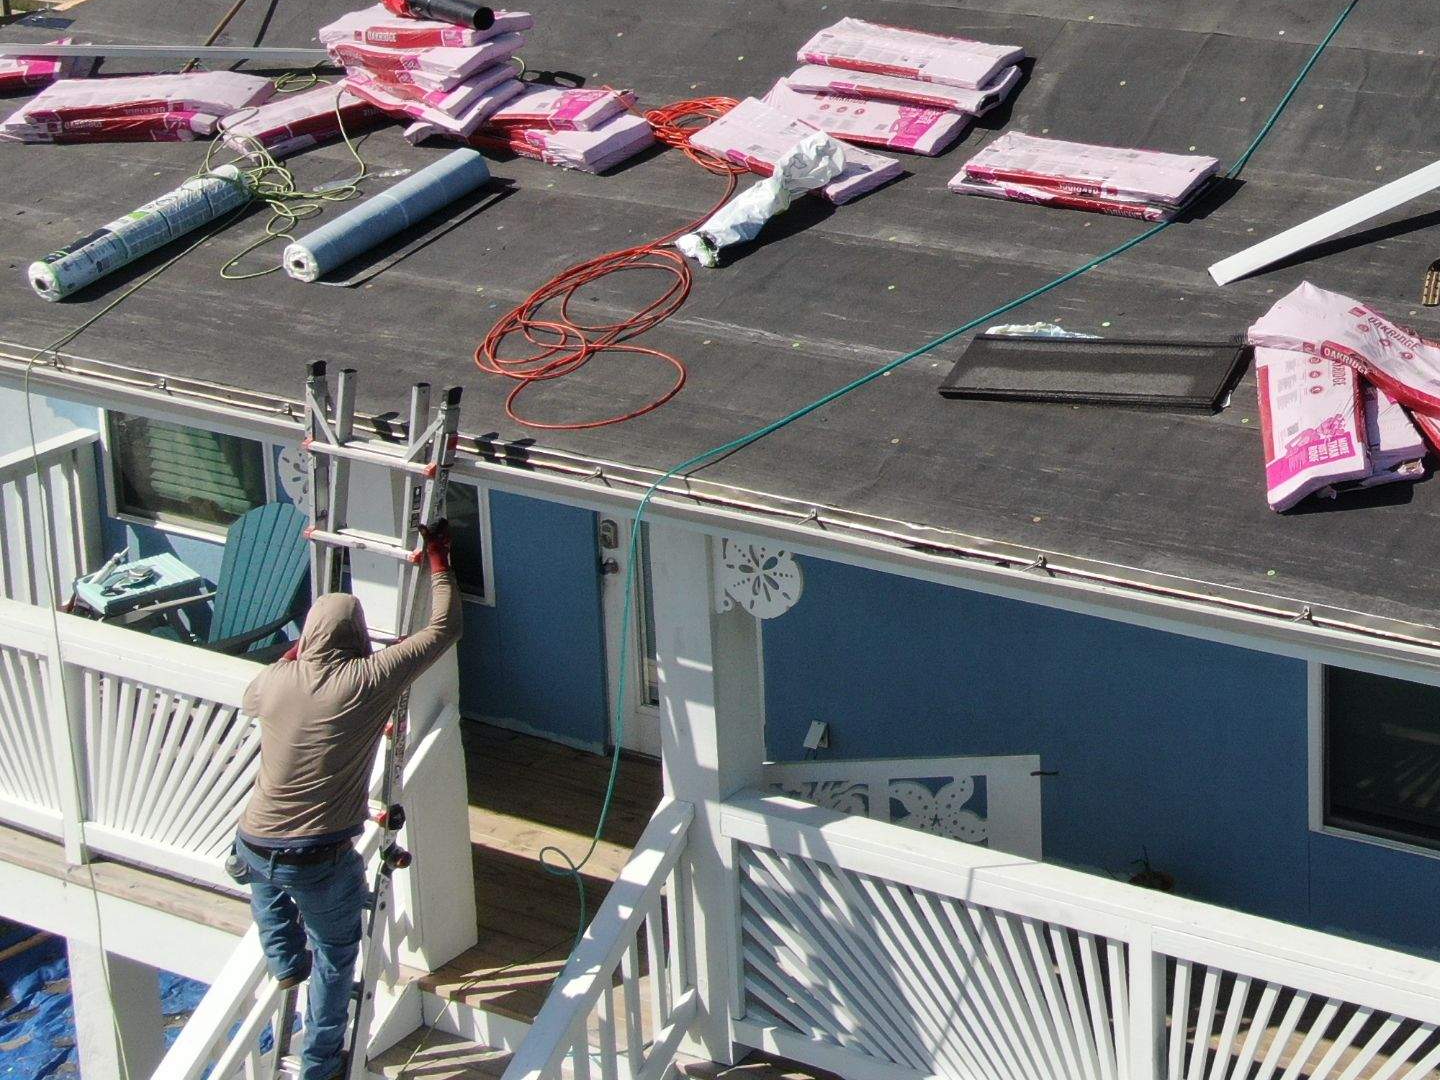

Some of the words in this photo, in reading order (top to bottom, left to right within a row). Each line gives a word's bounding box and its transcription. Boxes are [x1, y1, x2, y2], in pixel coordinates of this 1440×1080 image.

[1367, 317, 1421, 351] OAKRIDGE
[1323, 347, 1369, 375] OAKRIDGE
[1328, 440, 1339, 459] THAN
[1339, 437, 1349, 455] MORE
